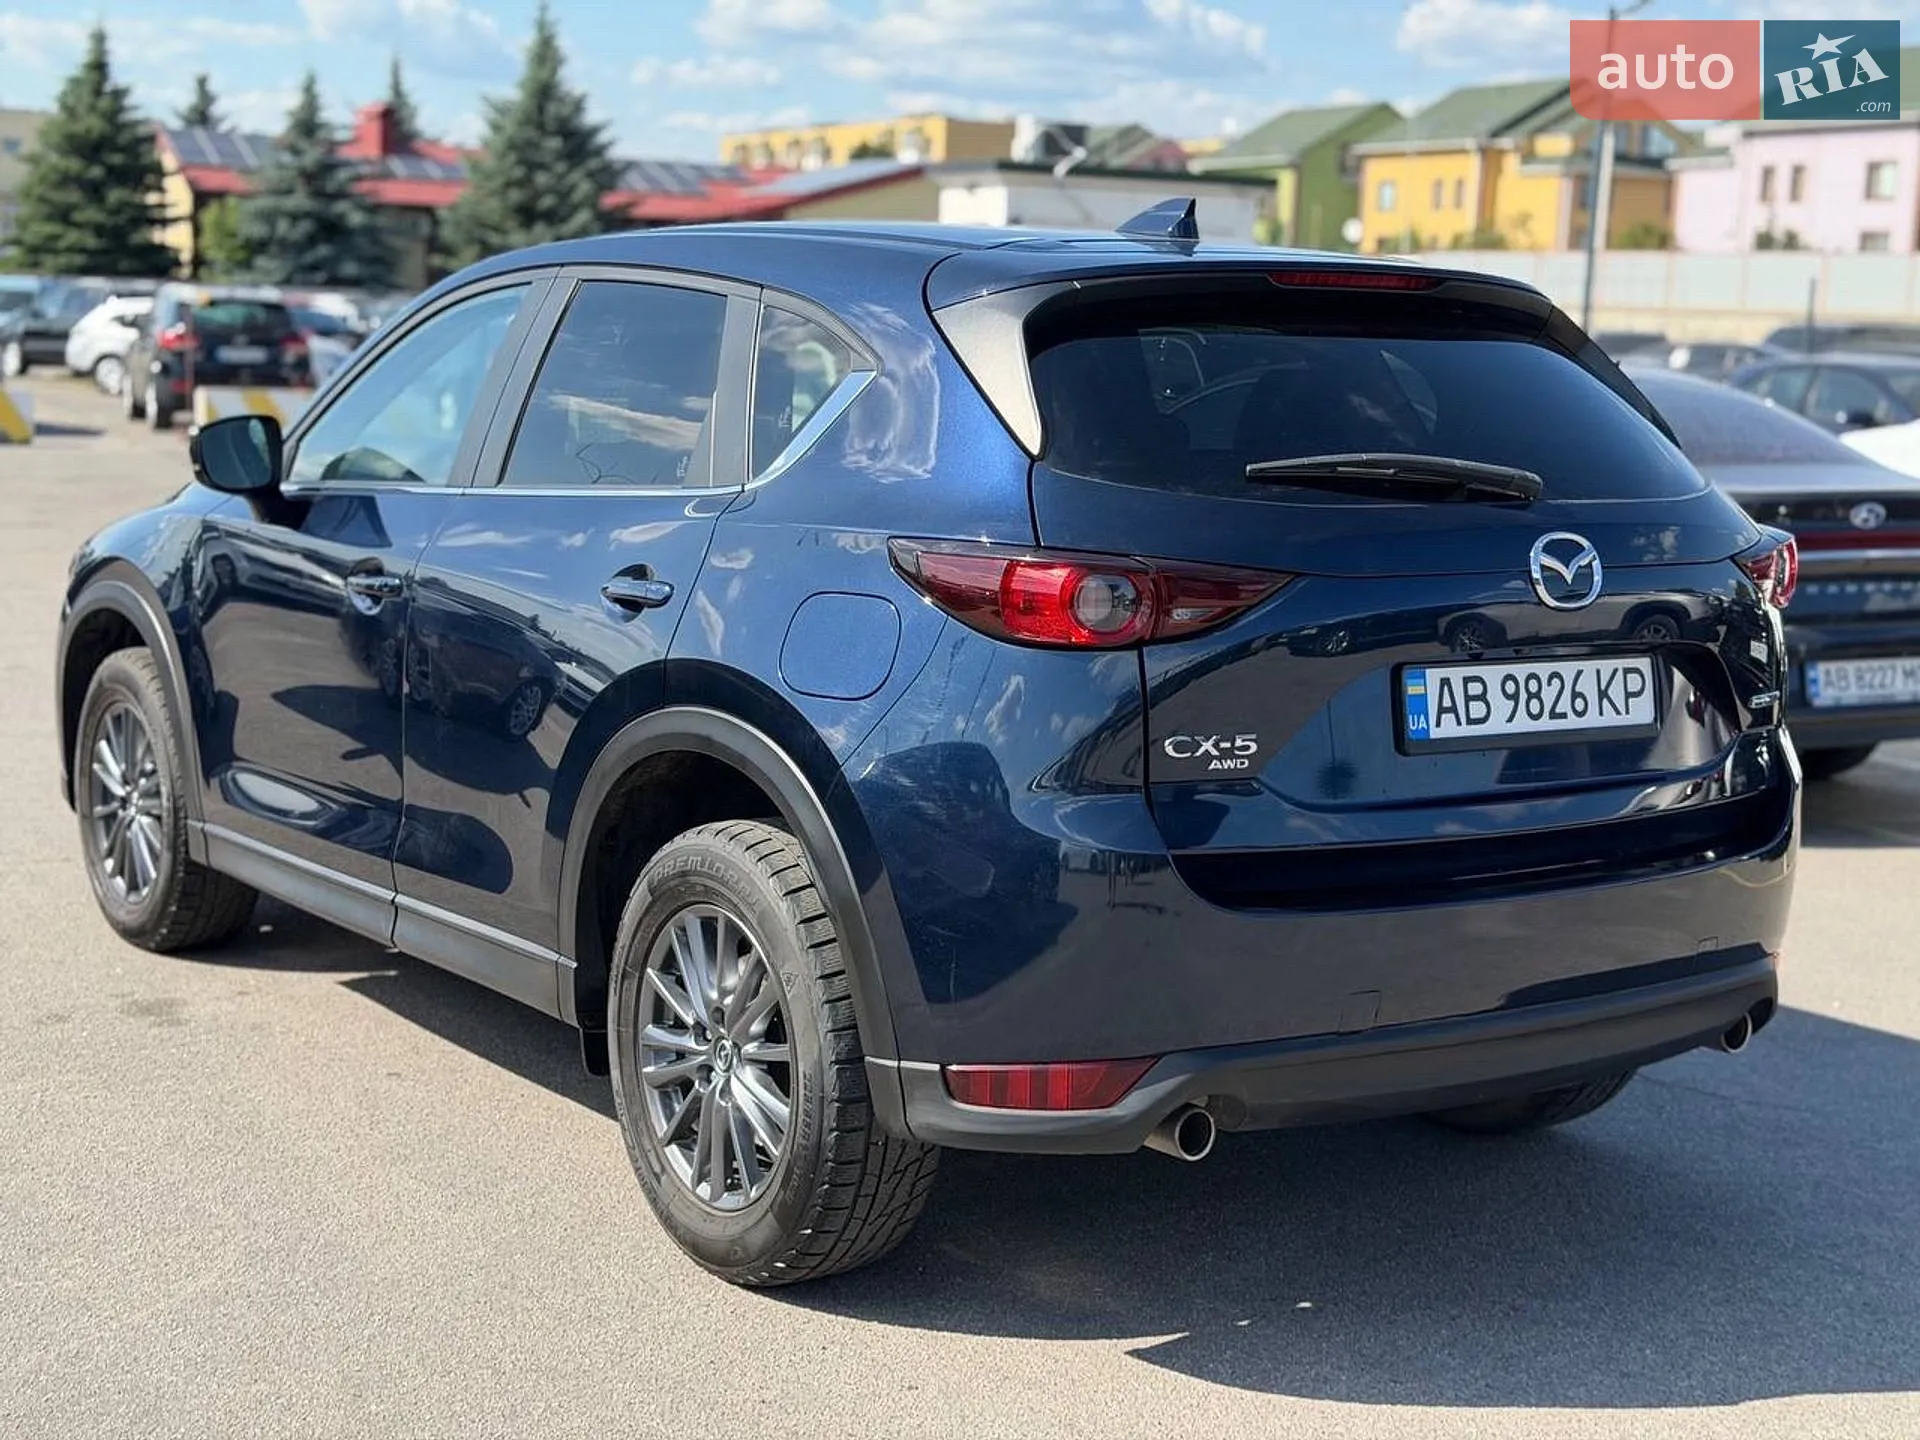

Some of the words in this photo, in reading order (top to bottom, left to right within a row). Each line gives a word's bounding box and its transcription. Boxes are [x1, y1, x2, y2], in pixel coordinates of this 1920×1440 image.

[1435, 675, 1492, 729] AB
[1500, 669, 1589, 724] 9826
[1596, 667, 1647, 716] KP
[1409, 714, 1428, 731] UA
[1164, 733, 1258, 758] CX-5
[1208, 758, 1249, 771] AWD
